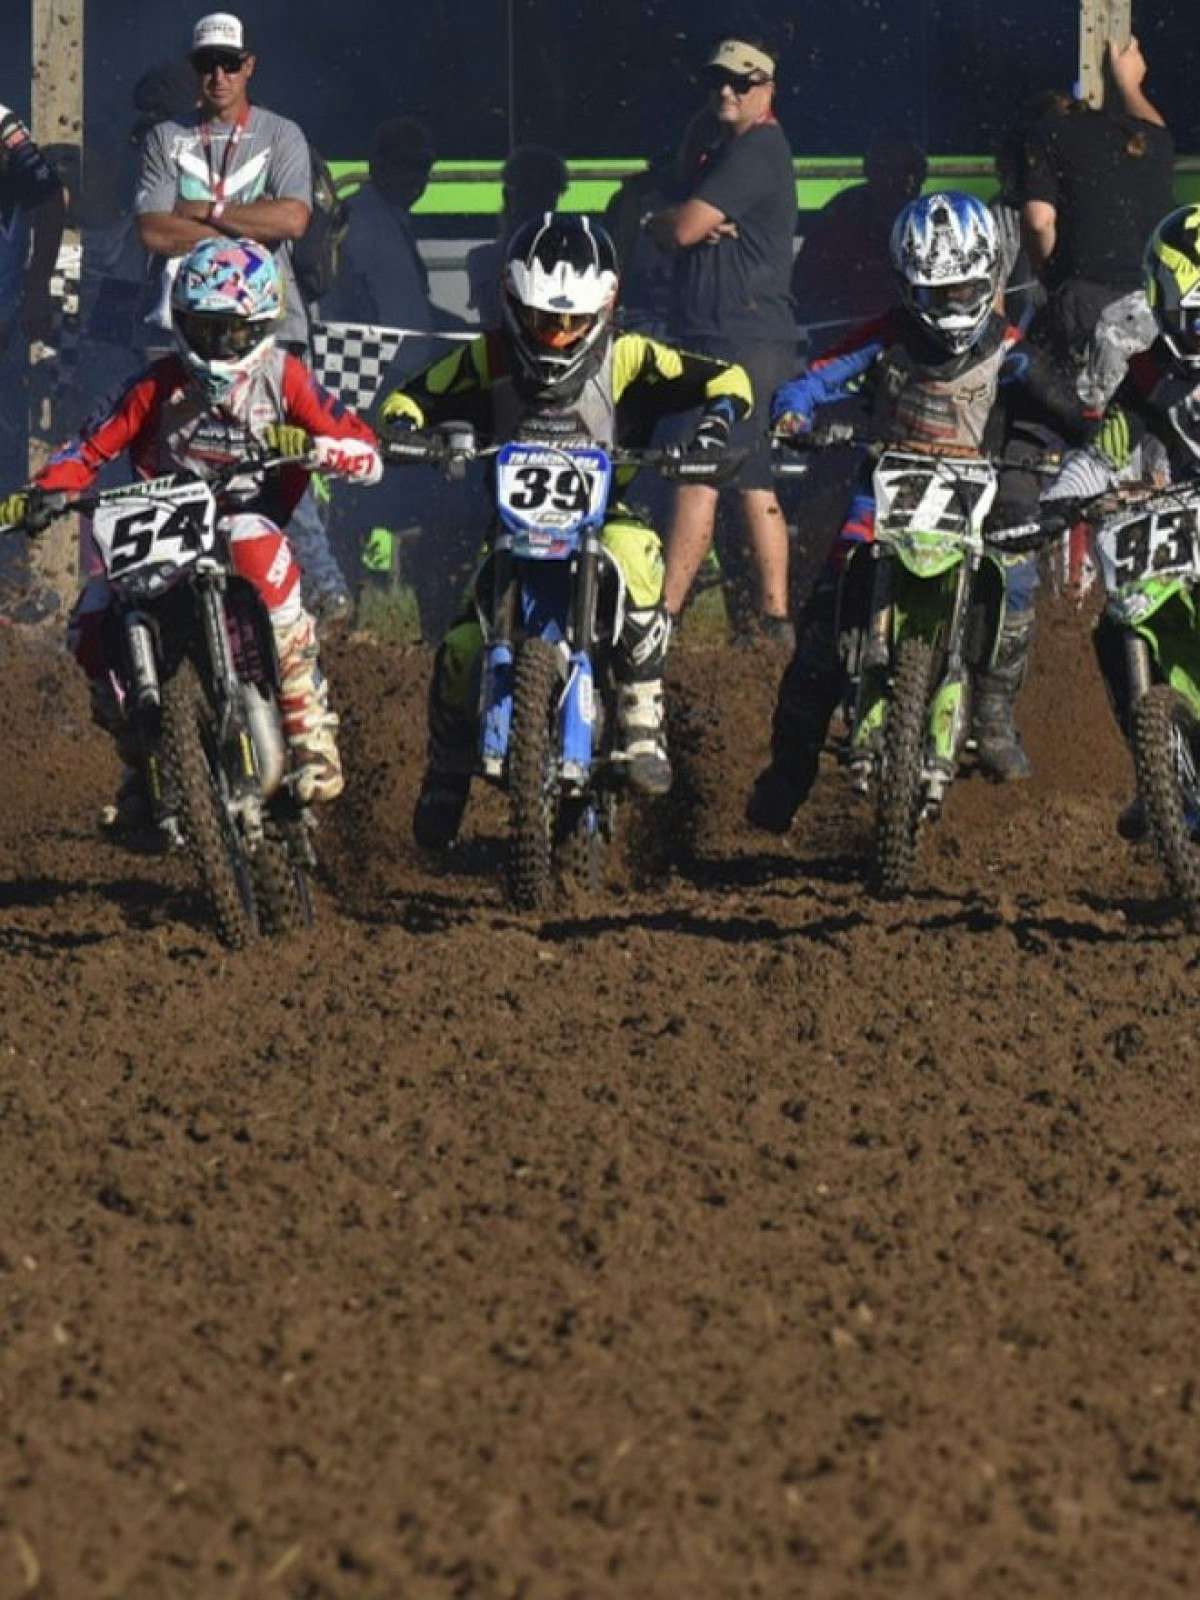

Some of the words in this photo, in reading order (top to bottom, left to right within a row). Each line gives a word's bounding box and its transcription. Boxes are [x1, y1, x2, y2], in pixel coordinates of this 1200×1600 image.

[509, 467, 594, 510] 39
[111, 500, 210, 574] 54
[1114, 509, 1198, 586] 93
